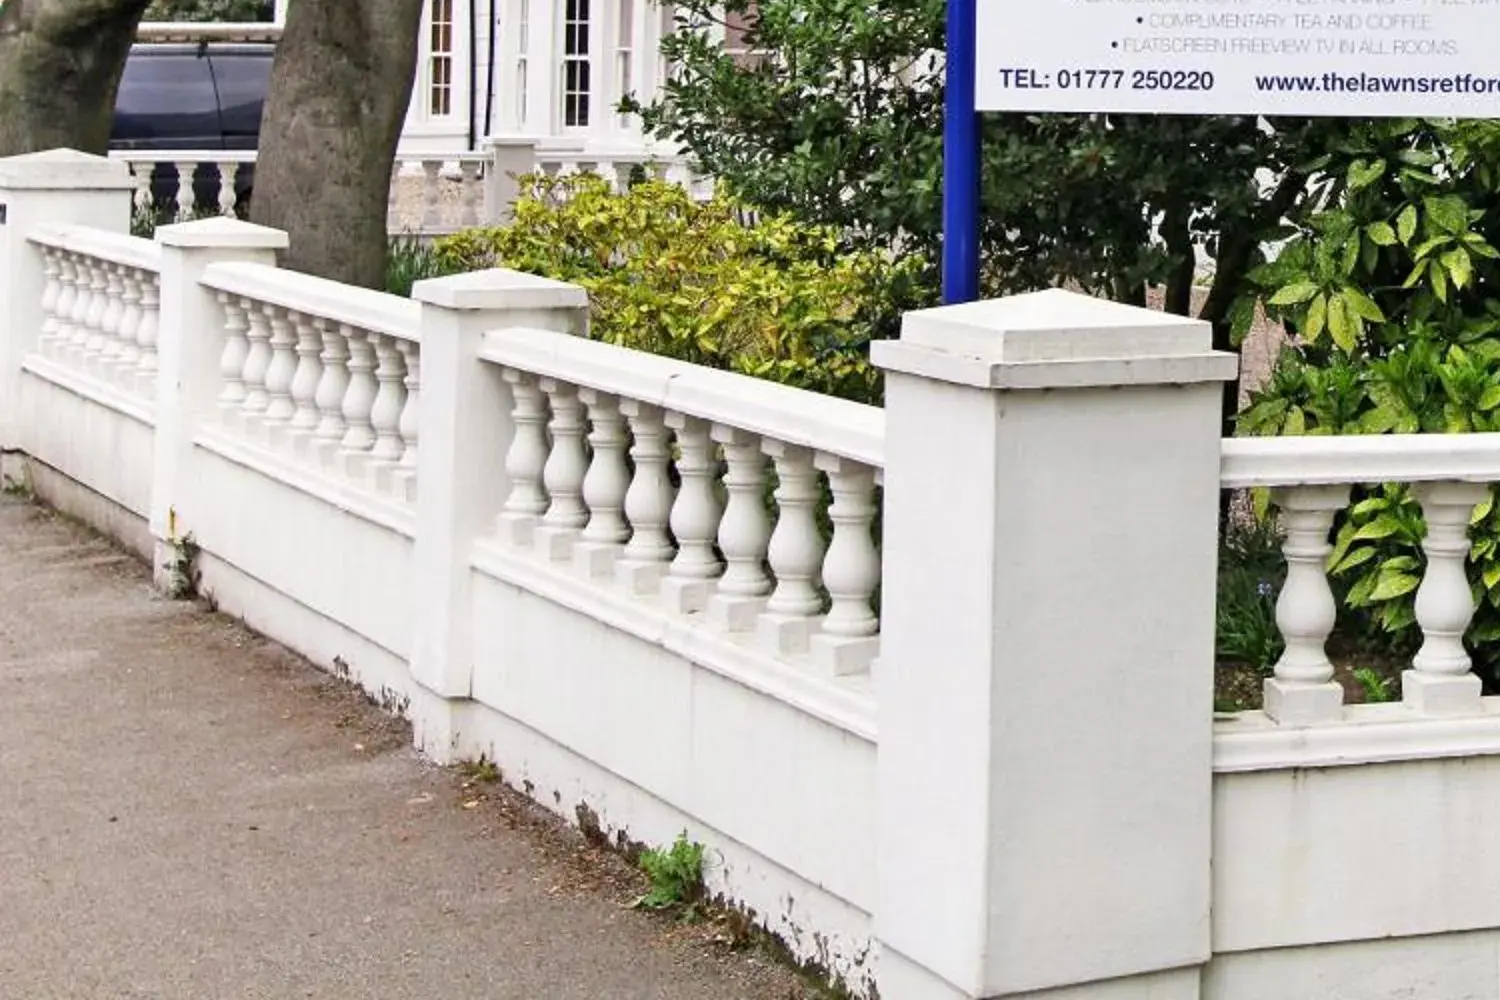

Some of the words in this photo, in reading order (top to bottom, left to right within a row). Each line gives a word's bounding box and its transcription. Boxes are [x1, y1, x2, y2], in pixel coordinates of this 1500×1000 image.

[1148, 12, 1286, 29] COMPLIMENTARY
[1294, 12, 1322, 29] TEA
[1326, 13, 1362, 30] AND
[1365, 13, 1433, 31] COFFEE
[1122, 36, 1227, 53] FLATSCREEN
[1231, 37, 1310, 54] FREEVIEW
[1315, 38, 1335, 54] TV
[1339, 38, 1355, 54] IN
[1358, 38, 1392, 55] ALL
[1393, 38, 1459, 56] ROOMS
[1000, 69, 1050, 89] TEL:
[1057, 69, 1124, 89] 01777
[1132, 70, 1214, 91] 250220
